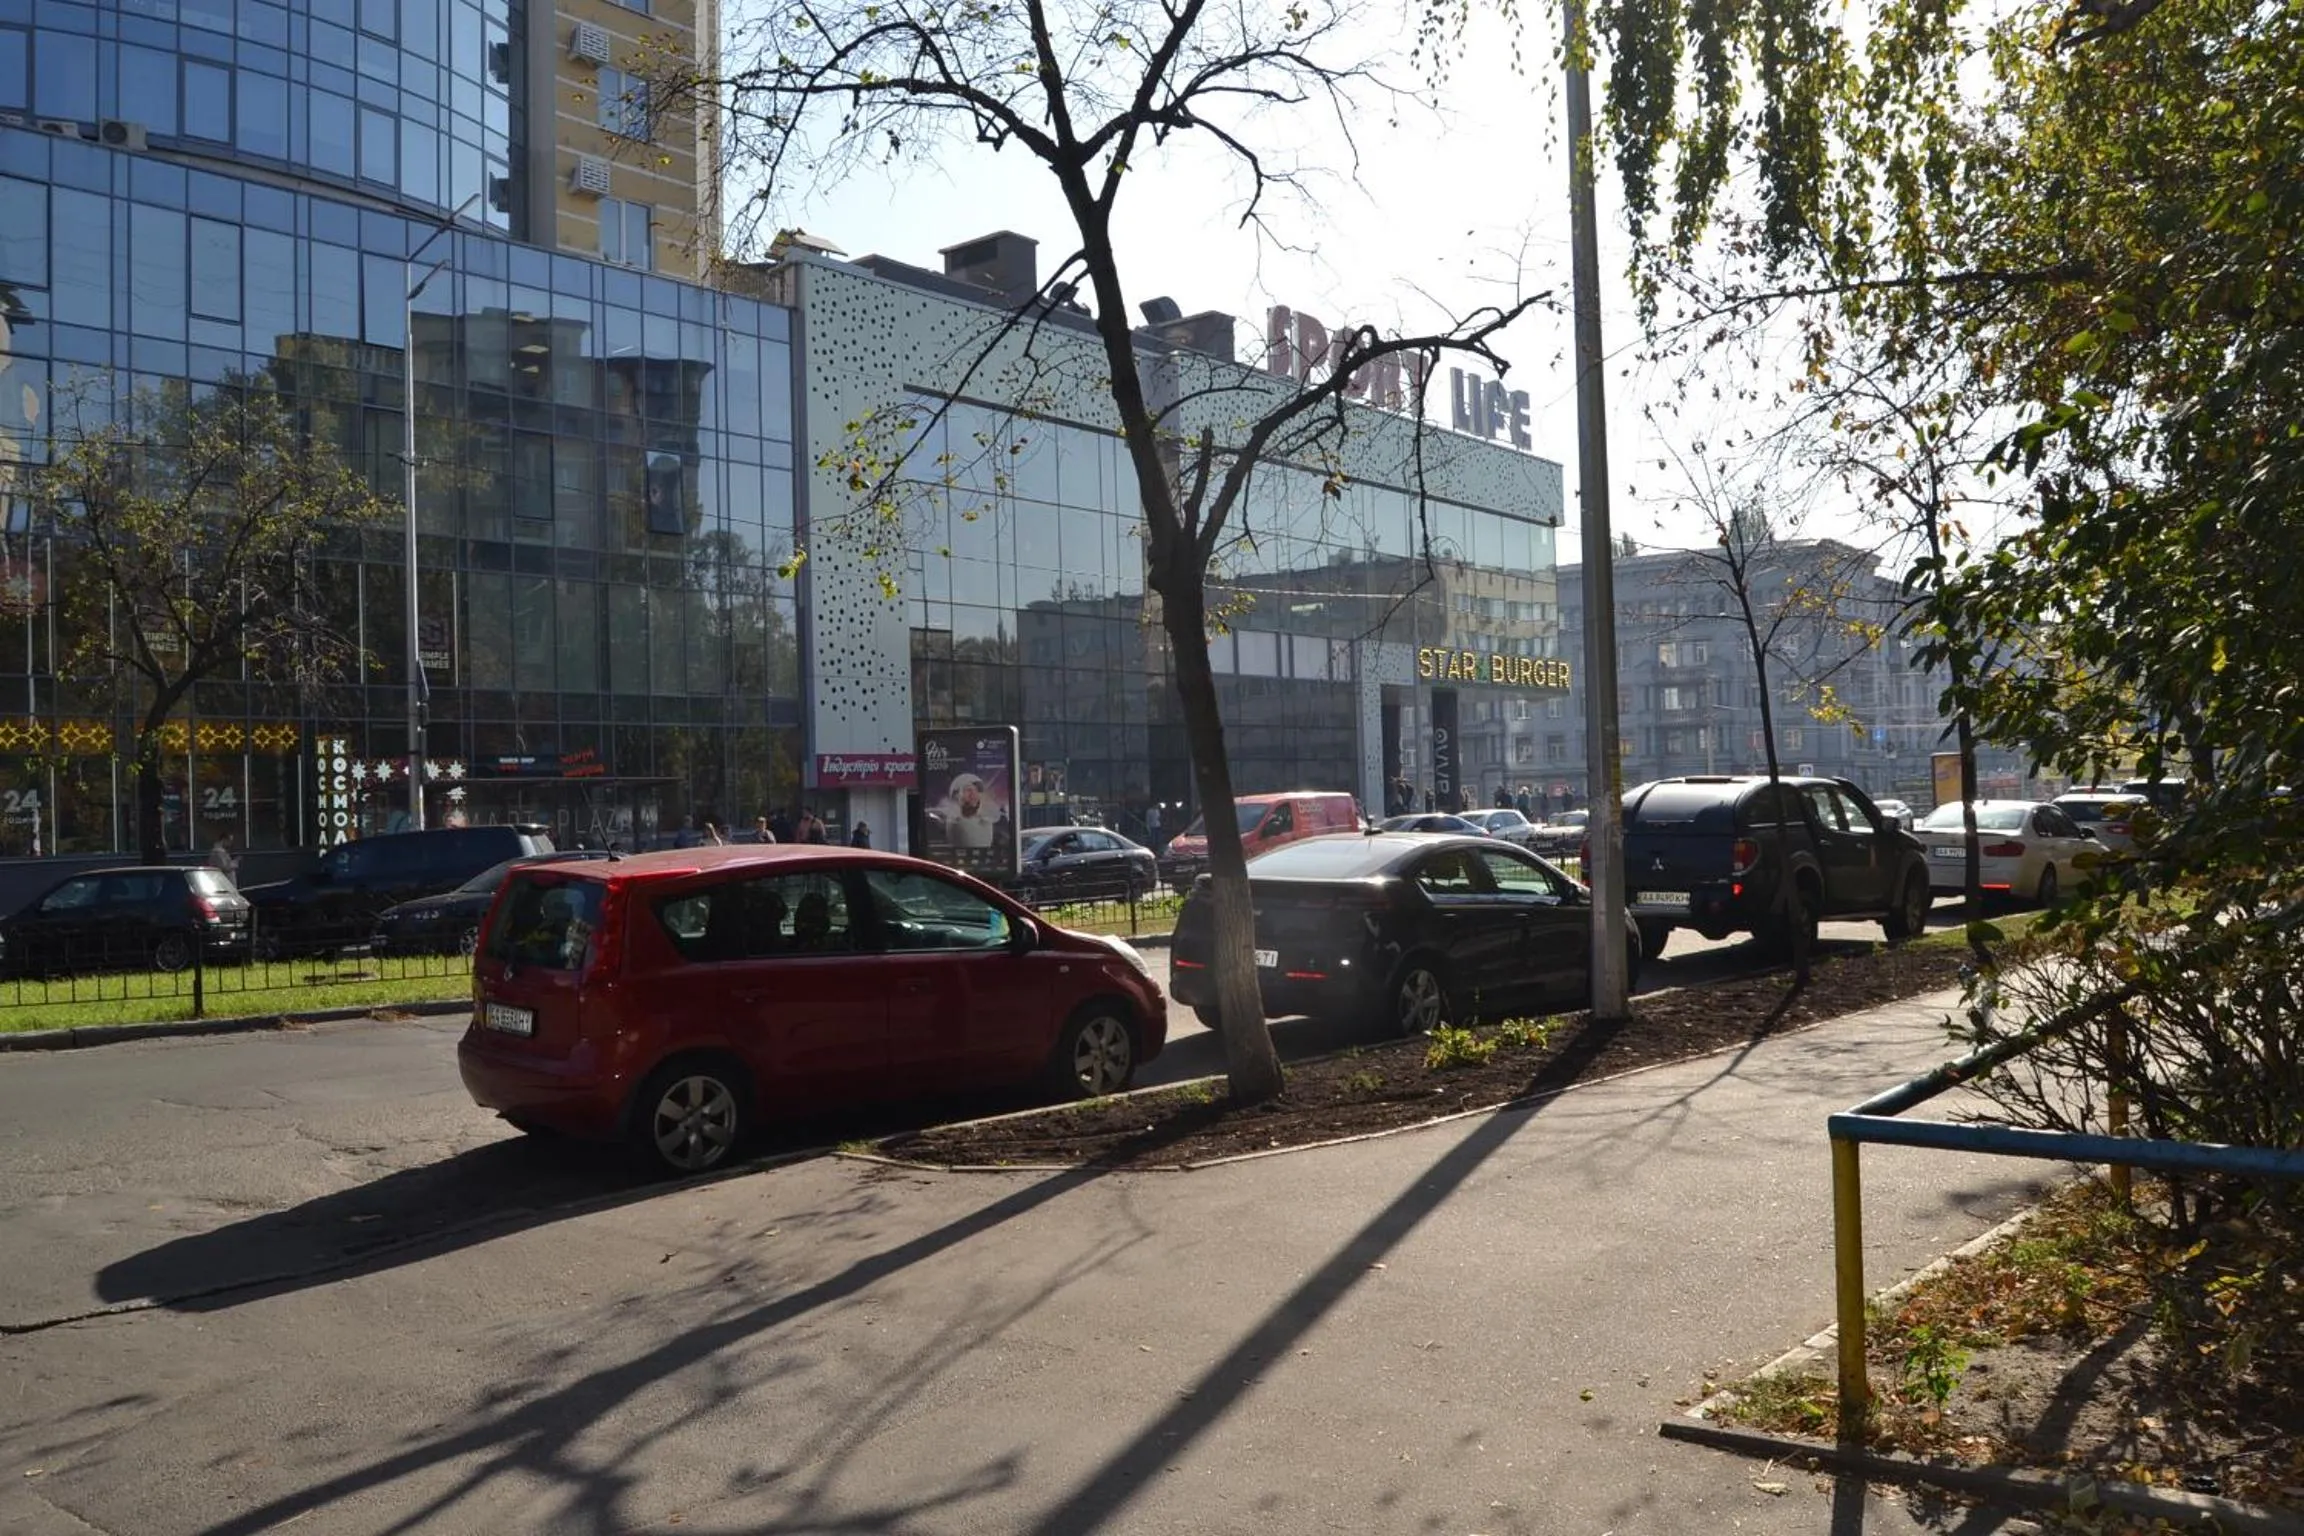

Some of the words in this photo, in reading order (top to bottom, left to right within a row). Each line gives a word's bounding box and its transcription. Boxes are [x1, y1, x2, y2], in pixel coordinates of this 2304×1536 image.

[1450, 367, 1532, 451] LIFE
[1418, 648, 1476, 681] STAR
[1492, 655, 1570, 688] BURGER
[3, 789, 41, 813] 24
[203, 786, 236, 808] 24
